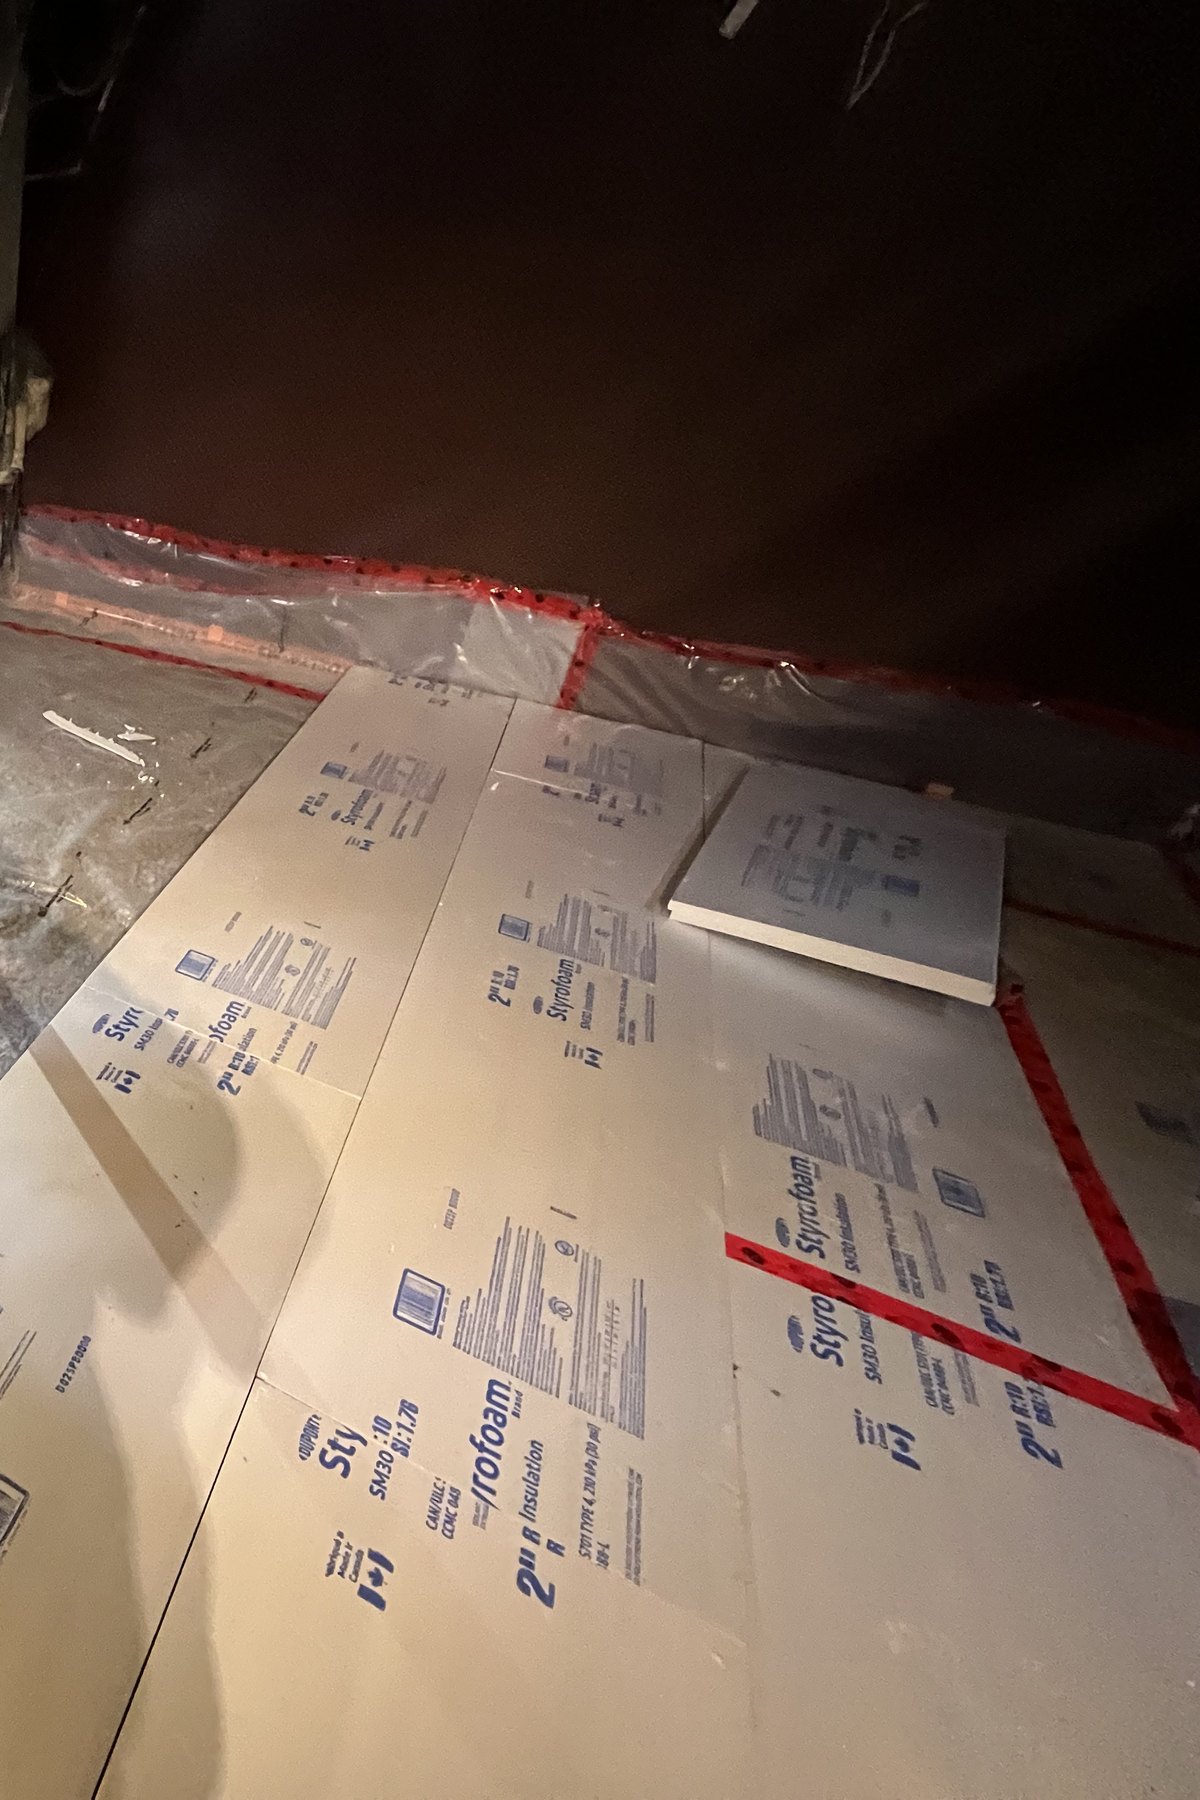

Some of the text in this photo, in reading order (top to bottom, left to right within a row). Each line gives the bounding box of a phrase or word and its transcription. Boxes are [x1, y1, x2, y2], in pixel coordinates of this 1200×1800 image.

[547, 958, 575, 1022] Styrofoam
[788, 1155, 830, 1259] Styrofoam
[810, 1294, 849, 1367] Styro
[980, 1304, 1021, 1343] 2"
[860, 1342, 883, 1385] SM30
[511, 1390, 523, 1418] Brand
[1004, 1381, 1063, 1469] 2" R:10
[369, 1450, 394, 1501] SM30
[518, 1440, 543, 1523] Insulation
[426, 1481, 446, 1530] CAN/ULC
[441, 1507, 459, 1540] CCMC
[580, 1505, 594, 1533] TYPE
[348, 1549, 364, 1583] Canada
[516, 1547, 556, 1609] 2"
